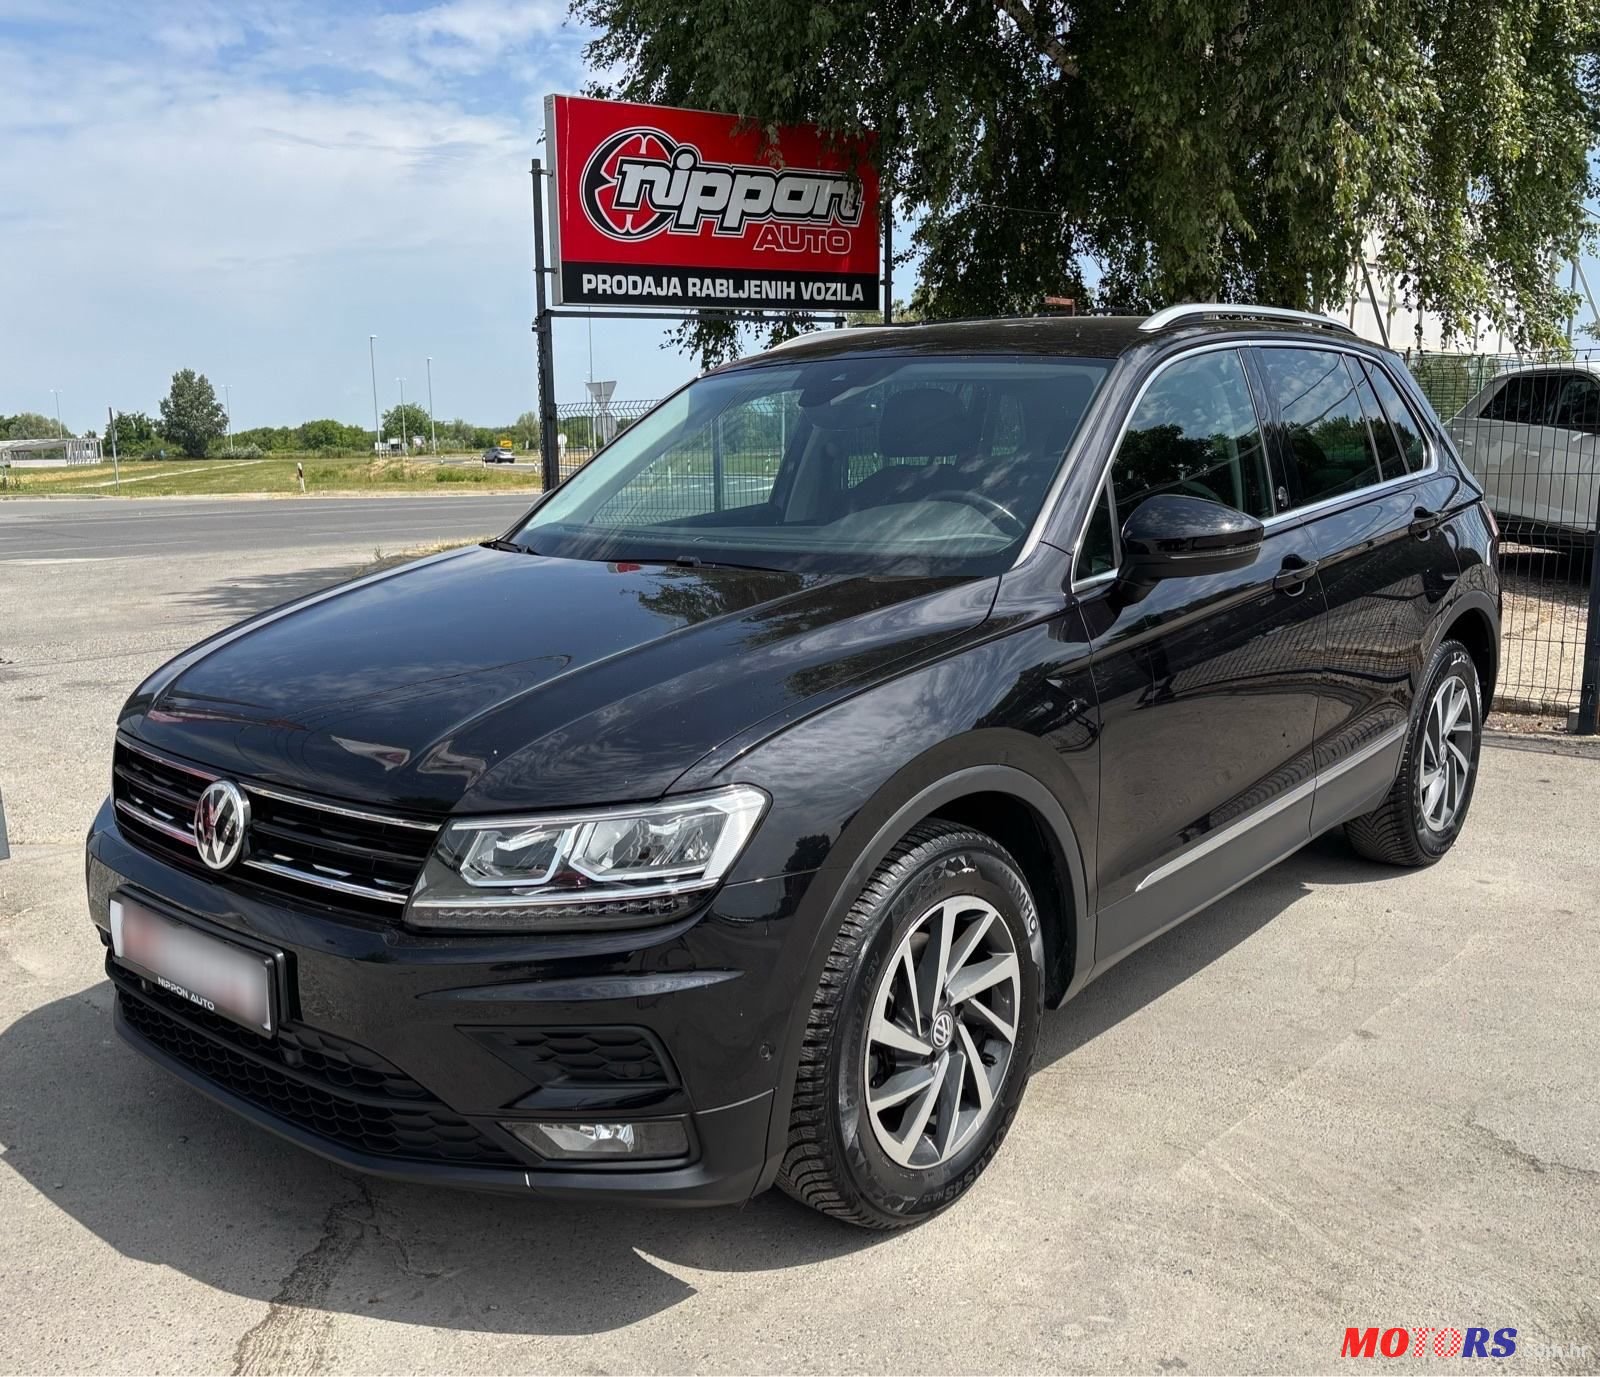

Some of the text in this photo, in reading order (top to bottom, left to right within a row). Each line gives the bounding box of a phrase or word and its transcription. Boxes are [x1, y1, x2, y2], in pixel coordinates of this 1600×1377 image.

[614, 146, 863, 236] nippon
[753, 224, 851, 254] AUTO
[582, 273, 864, 302] PRODAJA RABLJENIH VOZILA
[158, 976, 215, 1011] NIPPON AUTO
